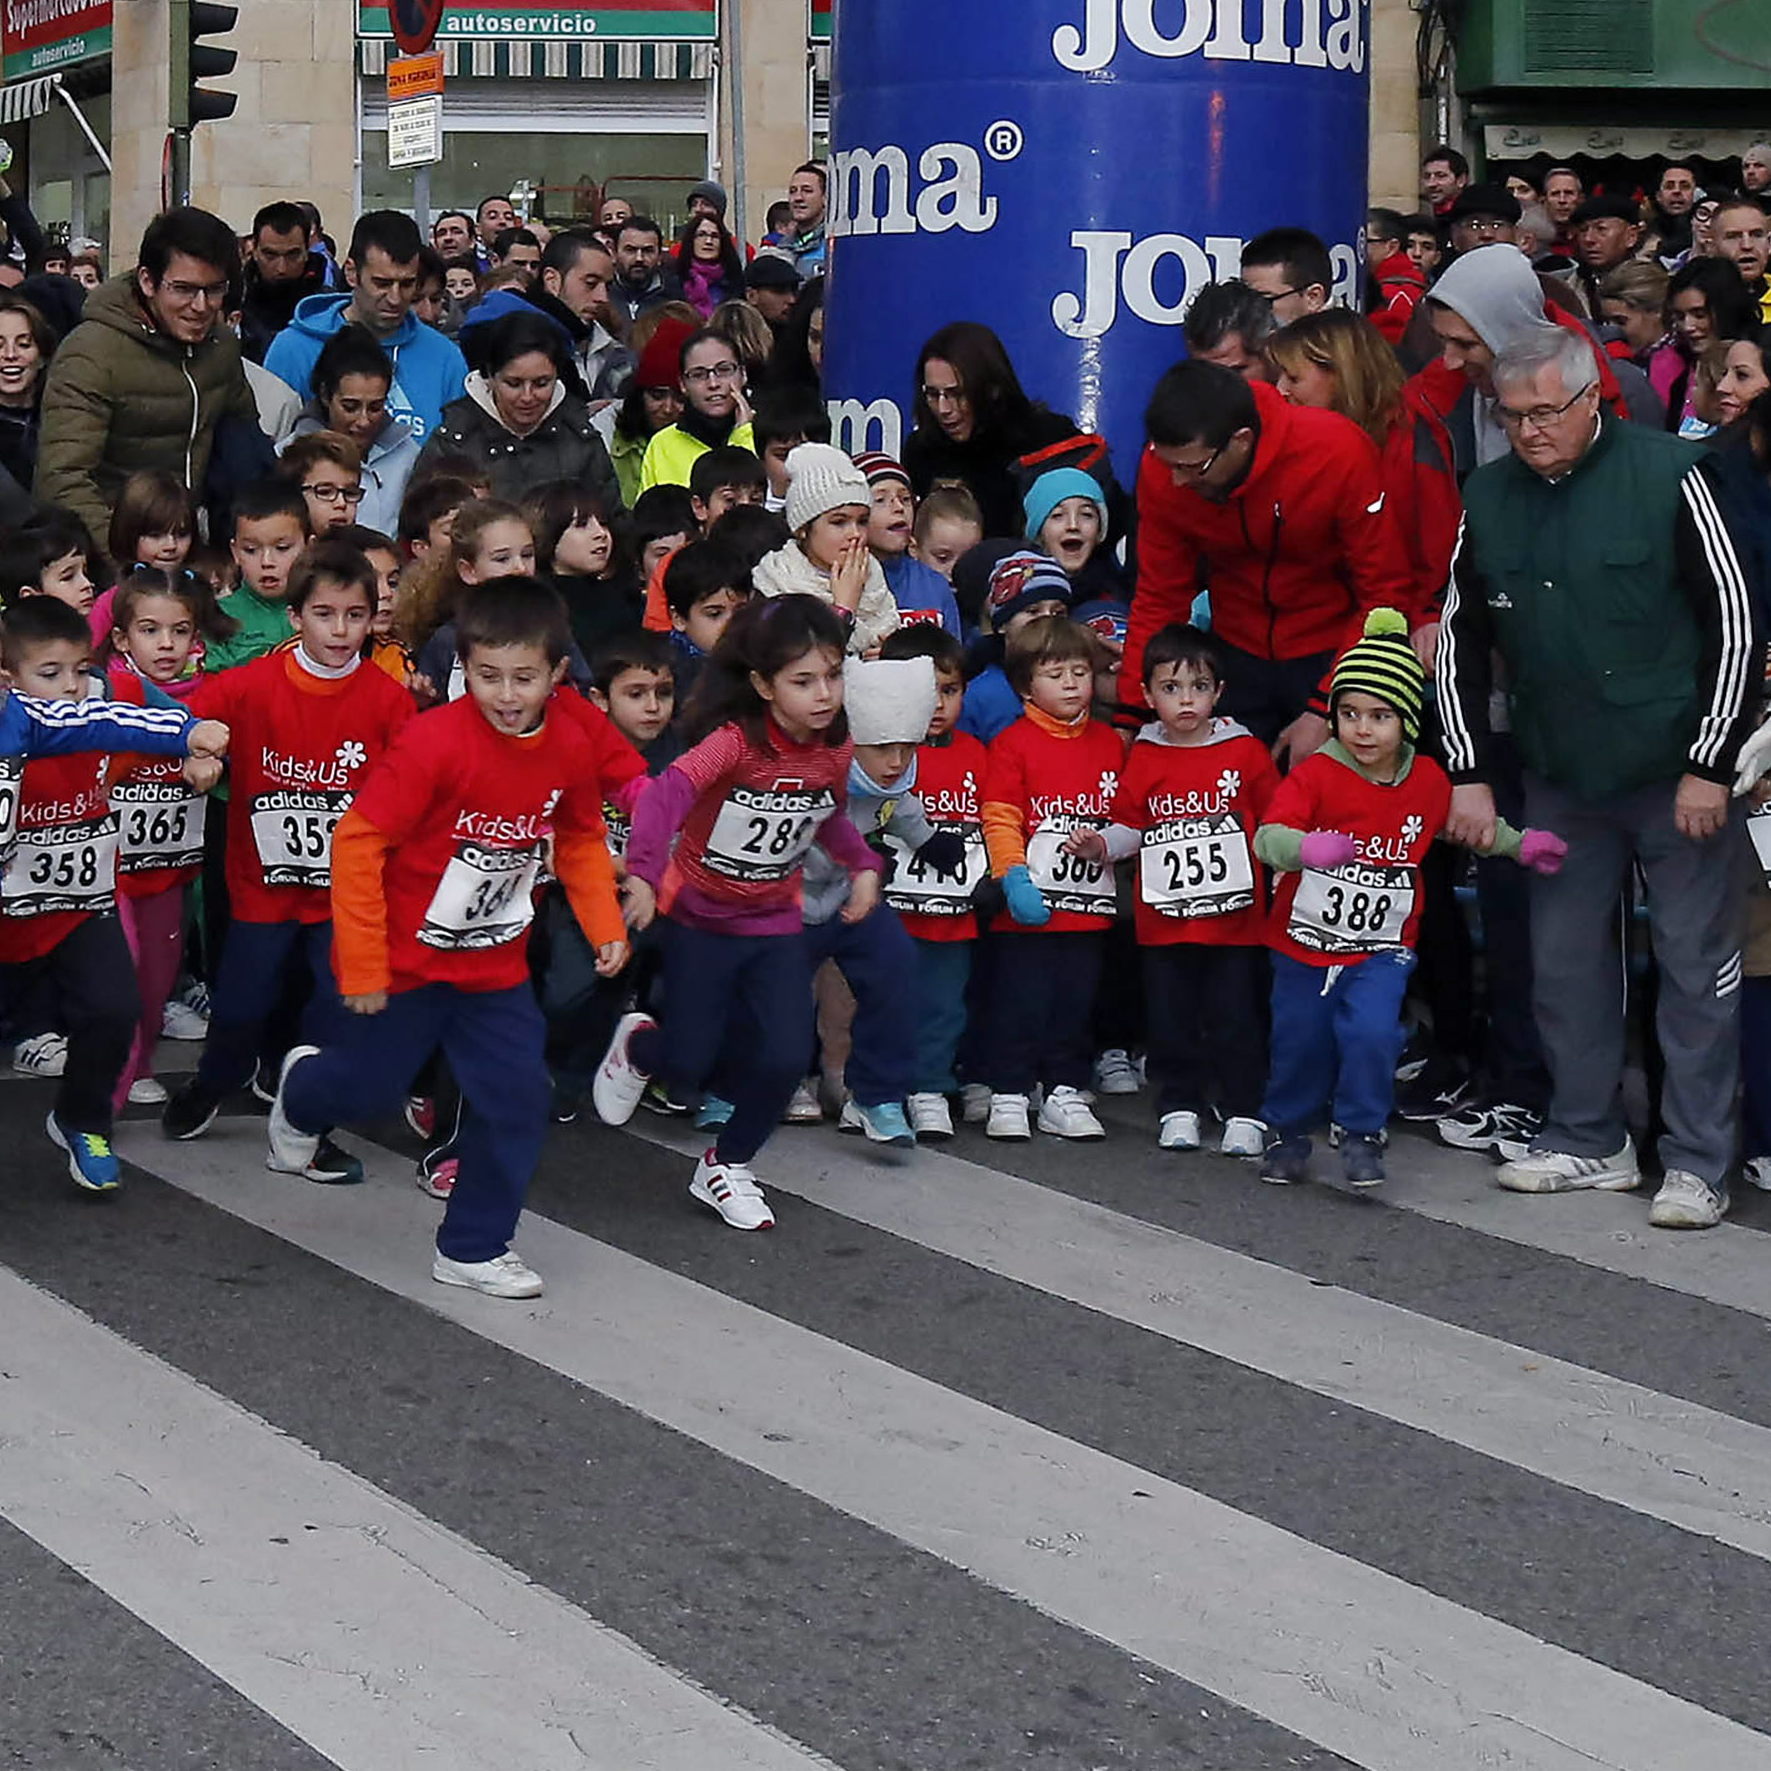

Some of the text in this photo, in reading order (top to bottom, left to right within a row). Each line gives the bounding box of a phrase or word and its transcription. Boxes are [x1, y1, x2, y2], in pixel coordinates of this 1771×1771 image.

[446, 13, 597, 34] autoservicio
[828, 141, 998, 239] ma
[112, 783, 184, 802] adidas
[254, 791, 329, 811] adidas
[734, 789, 813, 811] adidas
[15, 824, 91, 845] adidas
[127, 805, 189, 846] 365
[1144, 820, 1213, 845] adidas
[29, 845, 98, 888] 358
[1163, 842, 1227, 891] 255
[1321, 885, 1392, 932] 388
